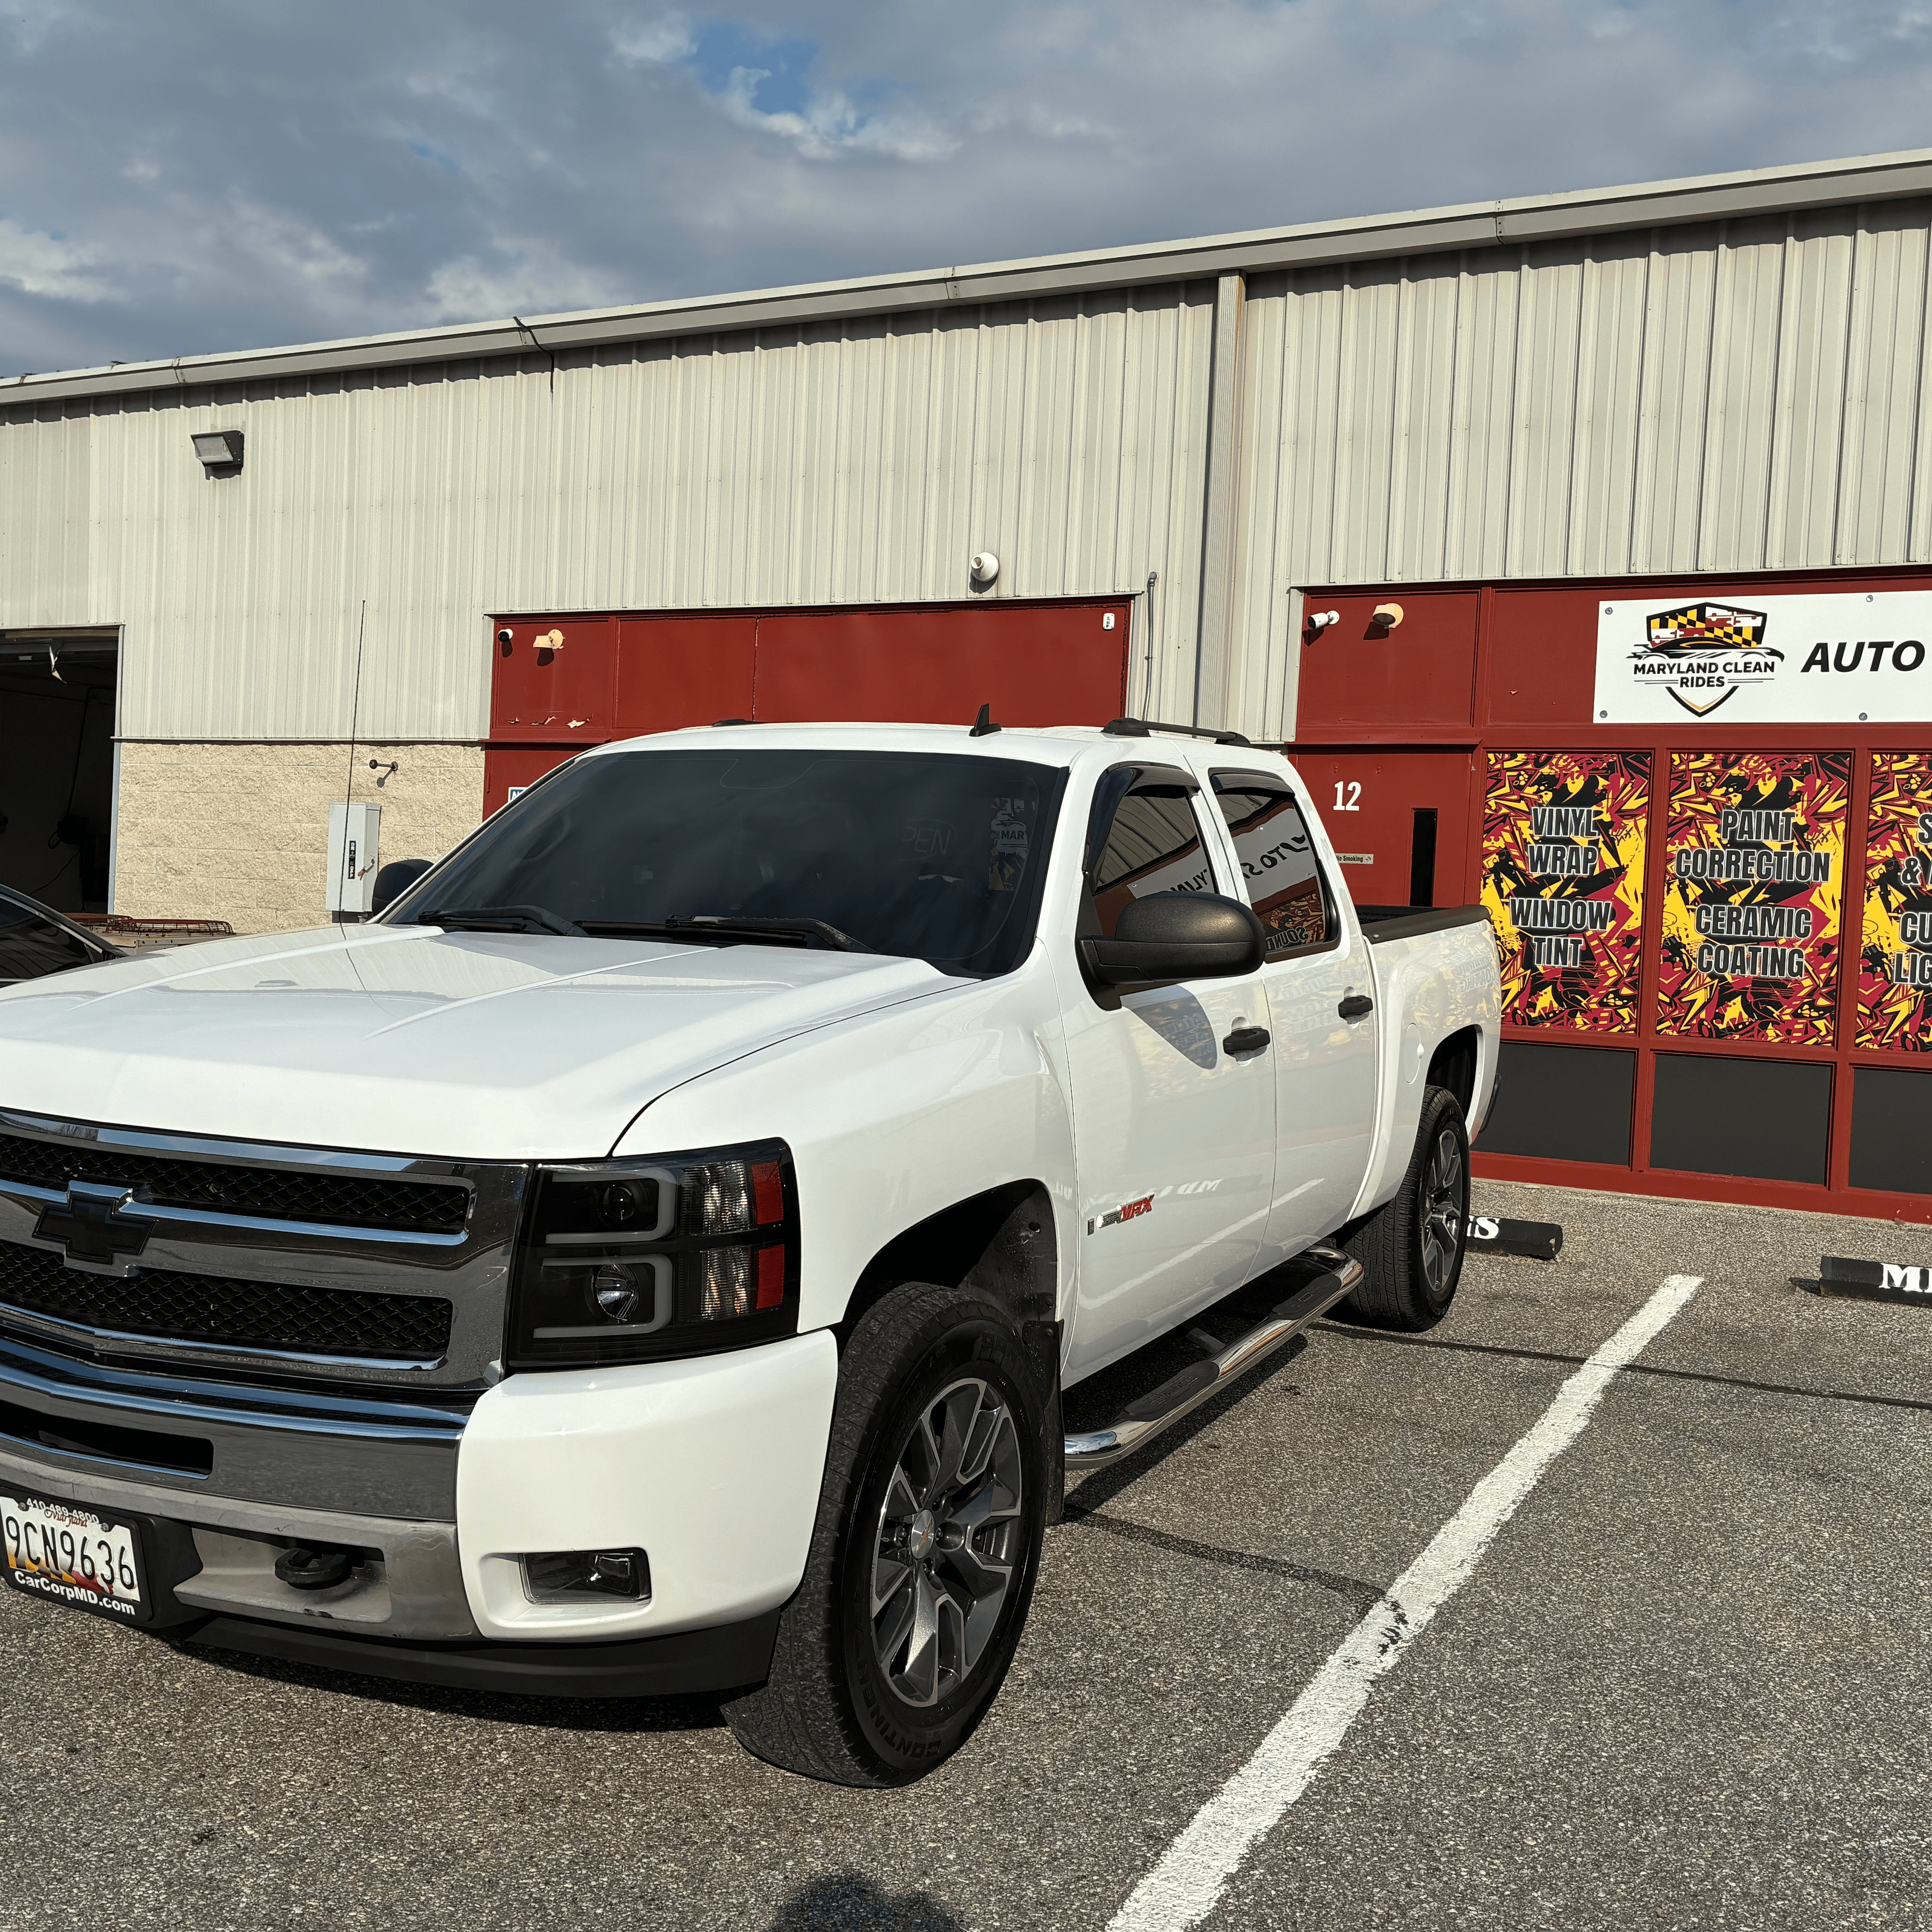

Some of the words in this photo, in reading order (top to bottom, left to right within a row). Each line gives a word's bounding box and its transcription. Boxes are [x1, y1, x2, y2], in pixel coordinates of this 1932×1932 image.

[1633, 662, 1719, 675] MARYLAND
[1722, 661, 1775, 674] CLEAN
[1800, 640, 1925, 673] AUTO
[1679, 676, 1725, 688] RIDES
[1333, 781, 1361, 811] 12
[1531, 807, 1600, 838] VINYL
[1721, 809, 1796, 843] PAINT
[1343, 855, 1363, 863] Smoking
[1528, 844, 1598, 876] WRAP
[1675, 848, 1830, 883] CORRECTION
[1509, 898, 1612, 930] WINDOW
[1694, 904, 1812, 939] CERAMIC
[1533, 936, 1584, 968] TINT
[1697, 942, 1805, 979] COATING
[26, 1498, 100, 1524] 410-489-4800
[6, 1515, 135, 1589] 9CN9636
[14, 1570, 136, 1616] CarCorpMD.com
